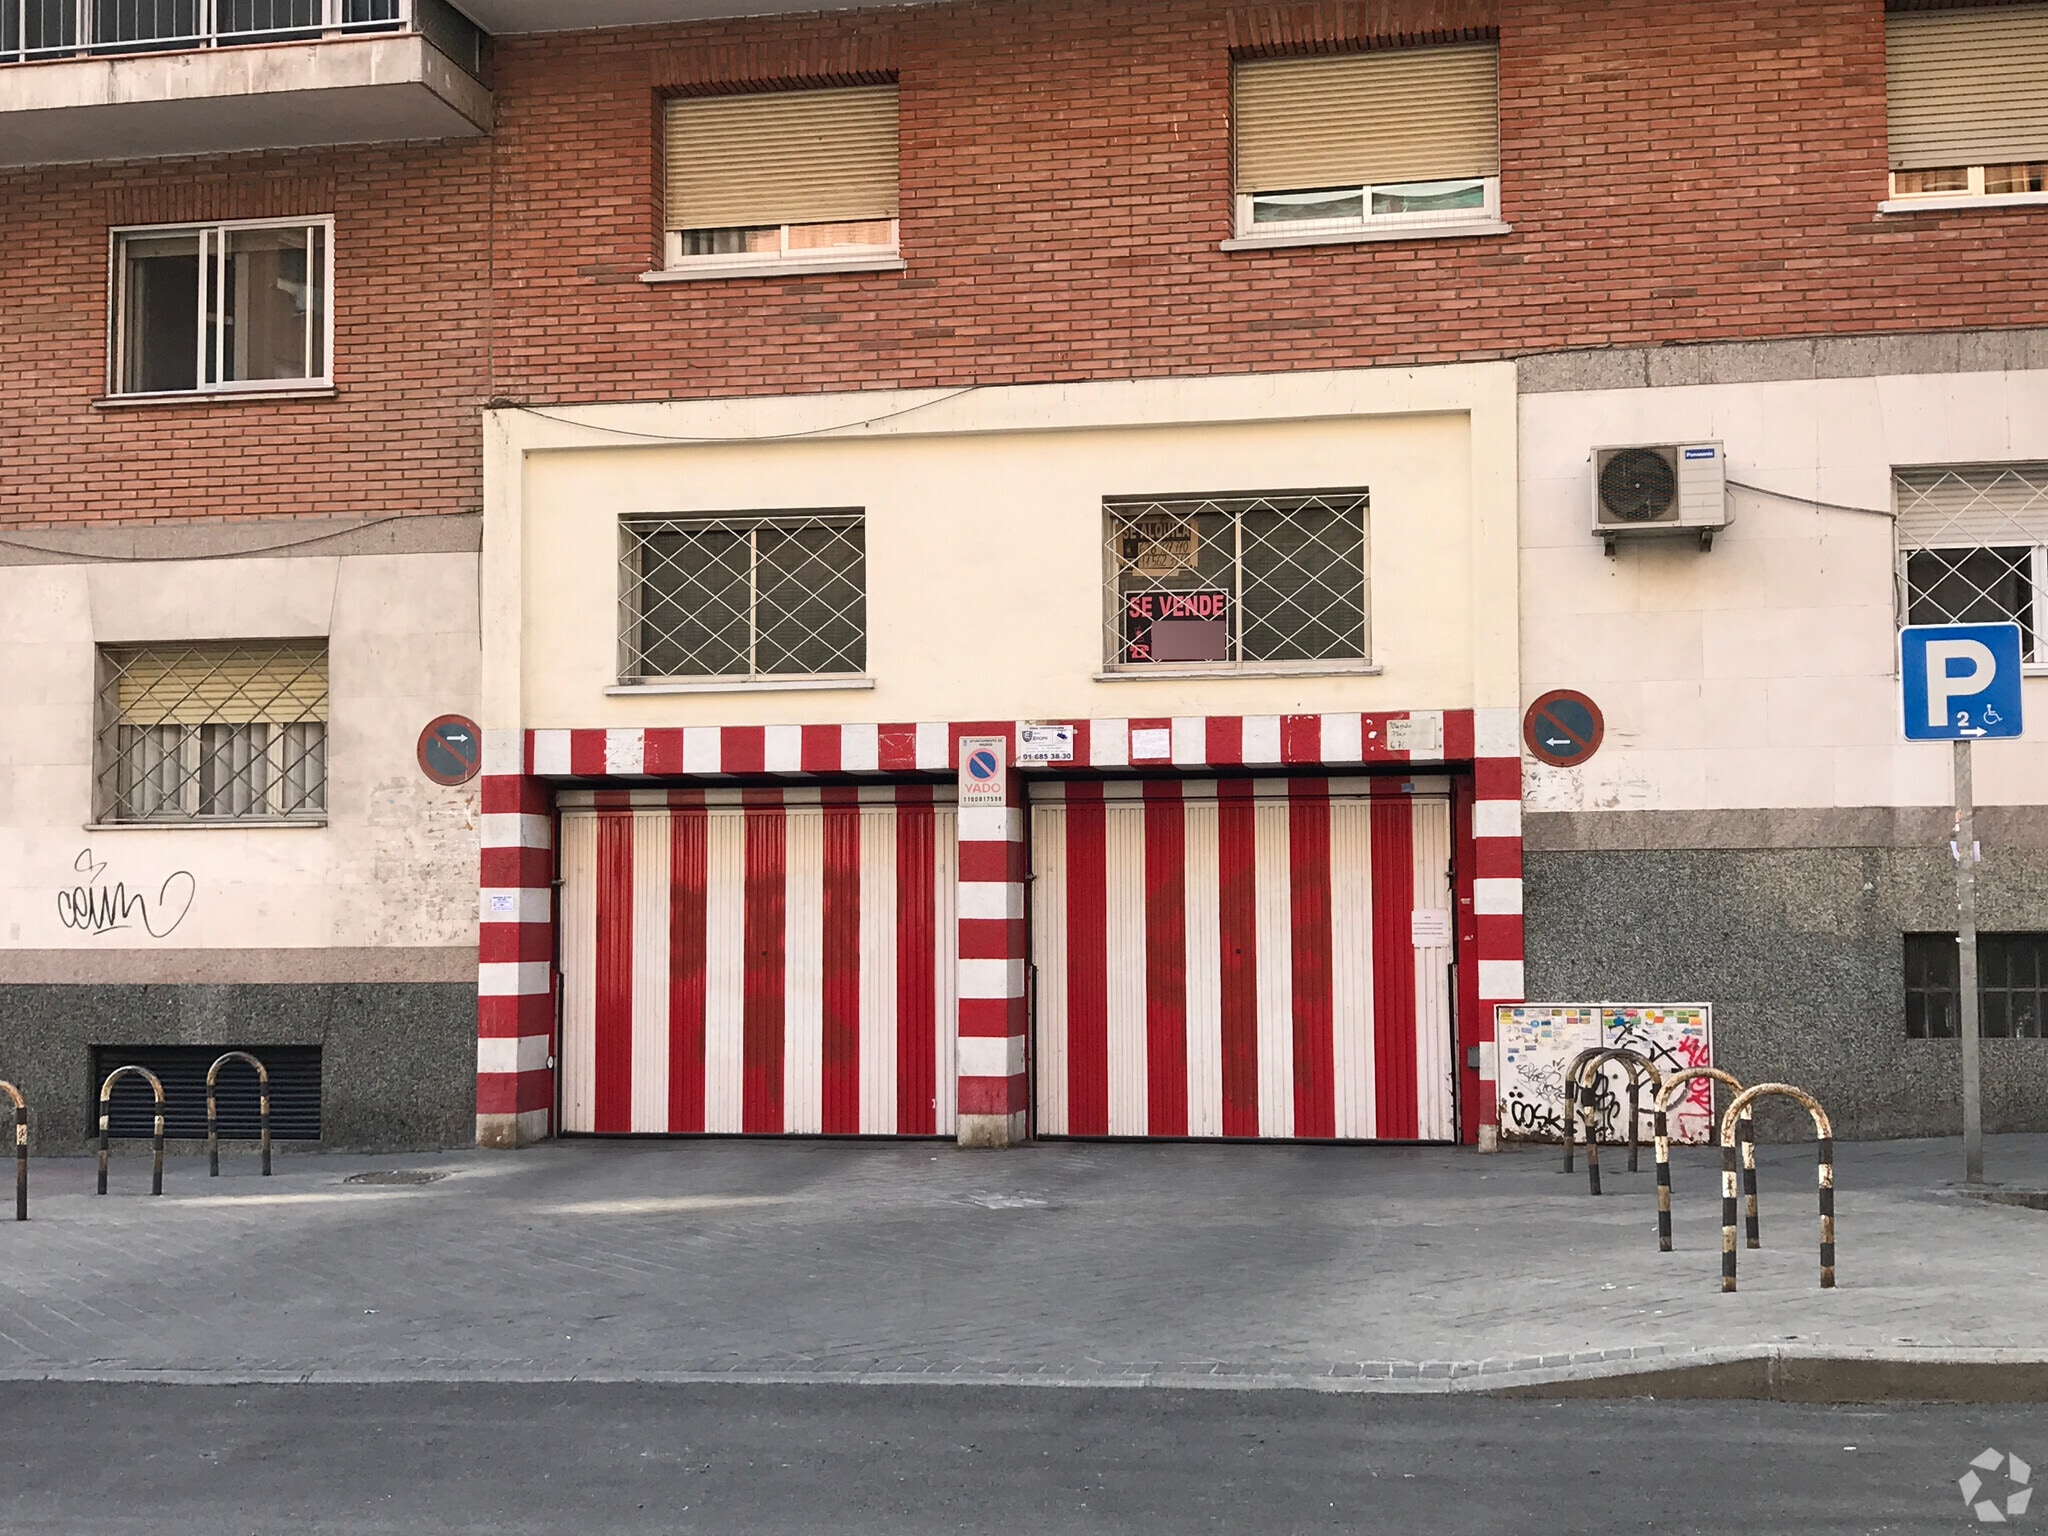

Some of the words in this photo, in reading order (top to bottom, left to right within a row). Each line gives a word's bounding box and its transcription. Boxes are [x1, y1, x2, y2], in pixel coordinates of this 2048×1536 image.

[1123, 525, 1137, 539] SE
[1140, 522, 1190, 538] ALQUILA
[1129, 596, 1152, 617] SE
[1159, 595, 1224, 616] VENDE
[1925, 639, 1996, 727] P
[1956, 711, 1970, 727] 2
[964, 783, 1001, 793] VADO
